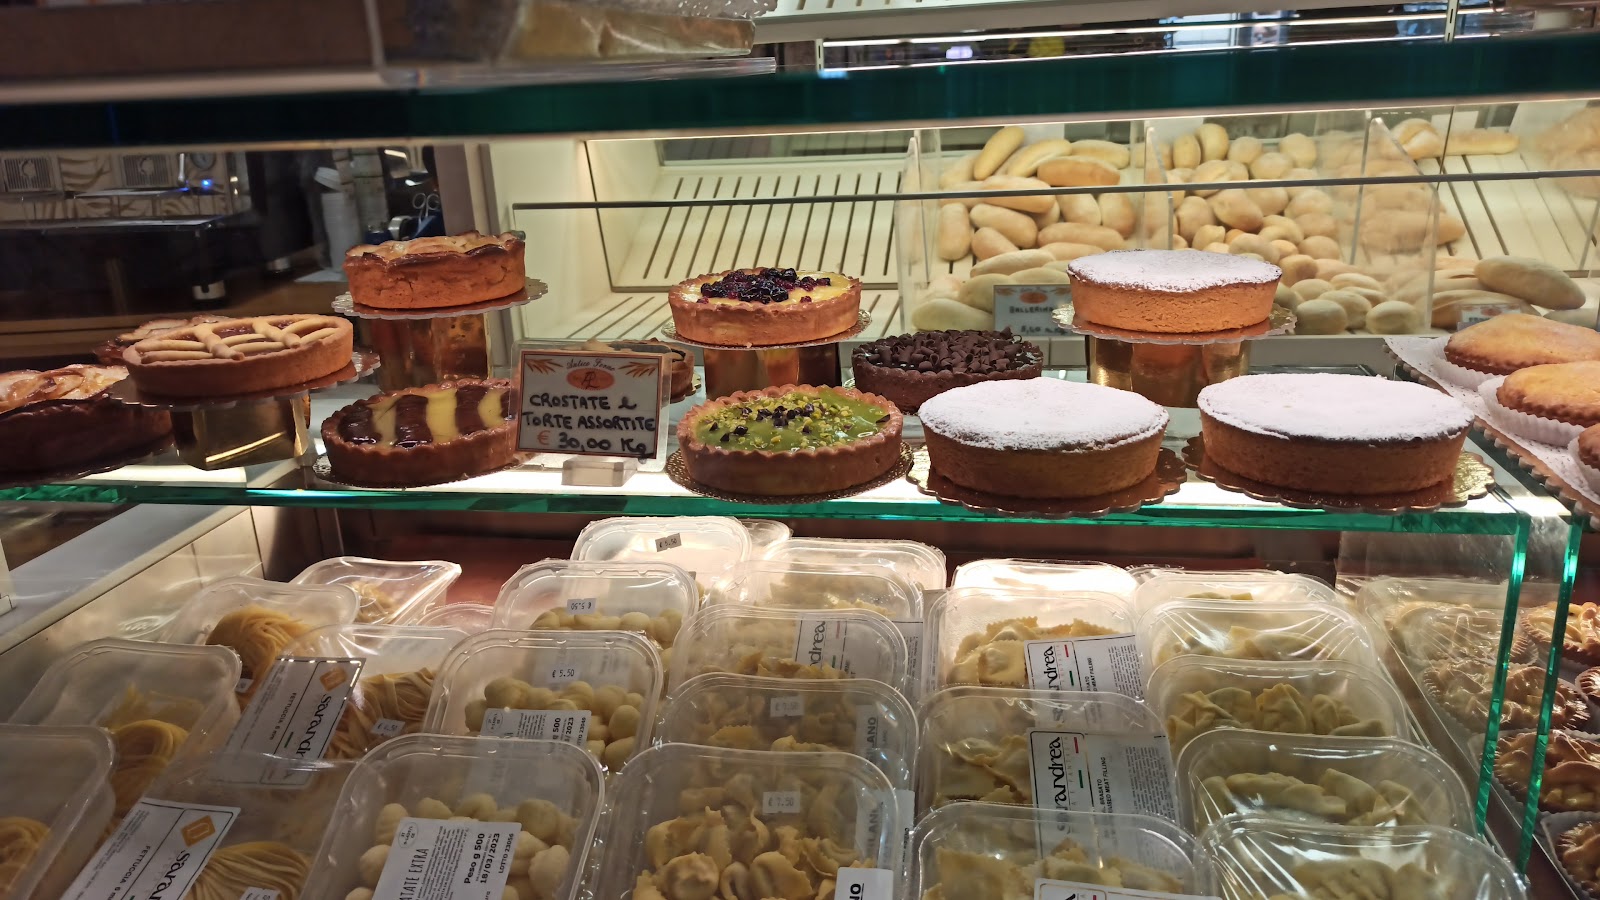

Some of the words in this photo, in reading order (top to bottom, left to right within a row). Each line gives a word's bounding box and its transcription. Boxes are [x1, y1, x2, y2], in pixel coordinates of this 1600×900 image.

[529, 392, 611, 410] CROSTATE
[521, 411, 573, 430] TORTE
[577, 415, 656, 432] ASSORTITE
[537, 430, 551, 446] €
[558, 432, 612, 453] 30,00
[621, 437, 654, 459] Kg
[559, 668, 575, 678] 5.50
[1043, 645, 1060, 691] ndrea
[276, 692, 297, 725] FETTUCCIA
[295, 693, 332, 757] sarandr
[553, 718, 561, 733] 500
[1048, 736, 1068, 811] randrea
[1100, 756, 1109, 778] FILLING
[119, 845, 151, 884] FETTUCCIA
[408, 848, 430, 873] EXTRA
[463, 861, 477, 884] Peso
[474, 833, 485, 850] 500
[480, 832, 500, 884] 18/03/2023
[498, 854, 509, 874] LOTTO
[504, 833, 514, 853] 23056
